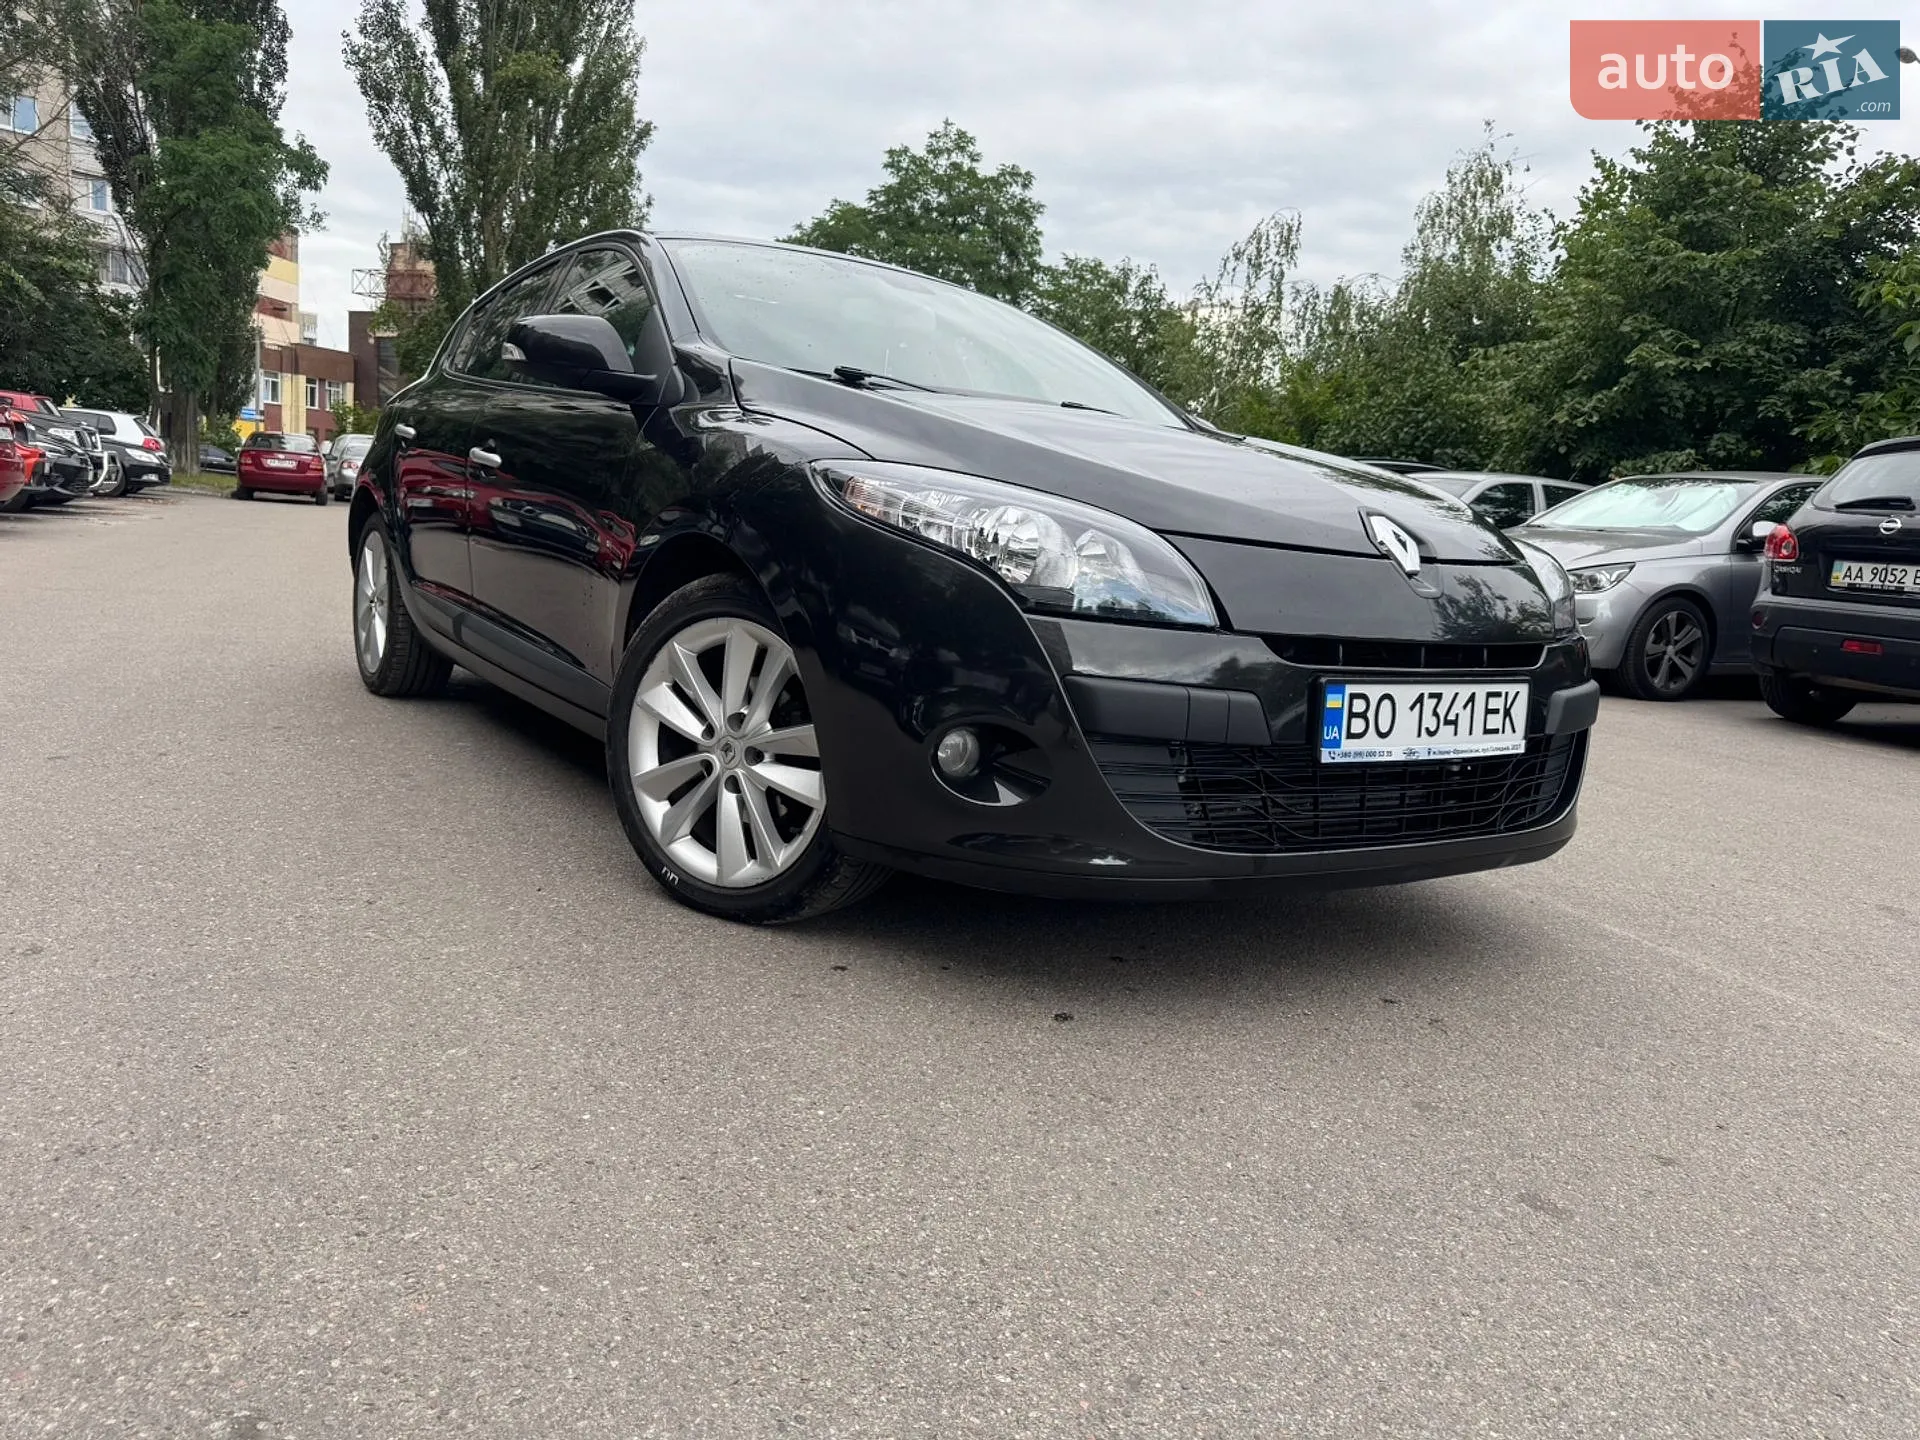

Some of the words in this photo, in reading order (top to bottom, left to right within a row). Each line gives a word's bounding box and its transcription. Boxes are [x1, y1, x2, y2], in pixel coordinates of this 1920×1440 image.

[1842, 565, 1863, 582] AA
[1870, 566, 1908, 584] 9052
[1346, 692, 1397, 740] BO
[1408, 691, 1476, 738] 1341
[1482, 690, 1520, 735] EK
[1323, 726, 1340, 740] UA
